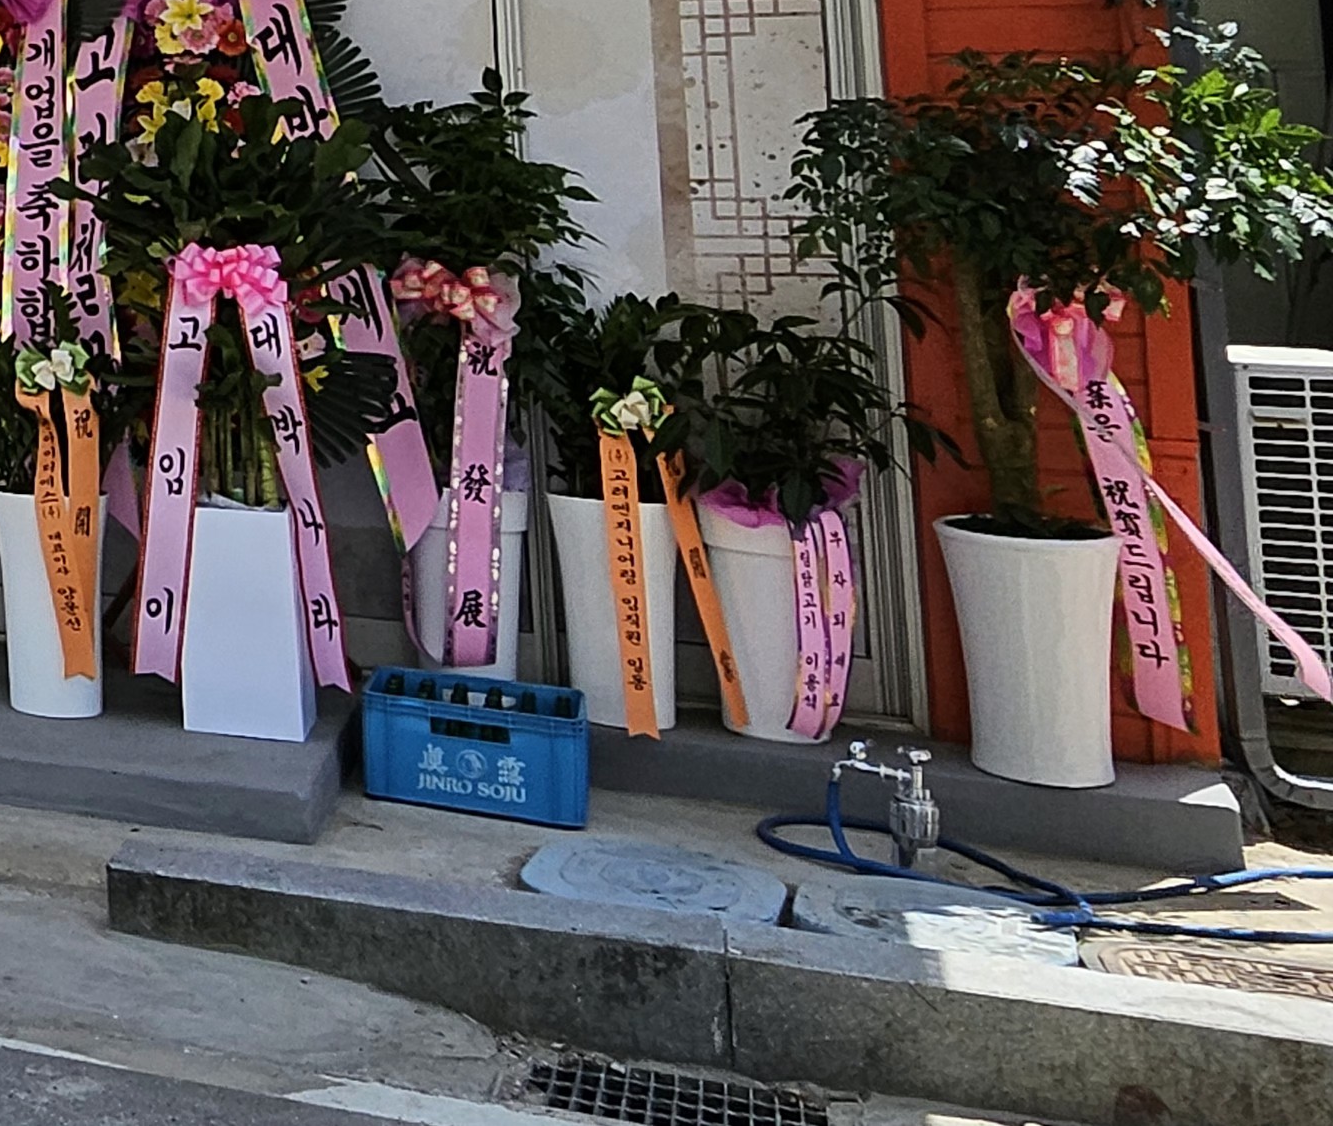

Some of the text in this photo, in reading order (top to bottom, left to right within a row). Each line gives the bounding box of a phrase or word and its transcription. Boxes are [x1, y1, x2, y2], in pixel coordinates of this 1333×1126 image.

[20, 29, 60, 169] 개업을
[146, 316, 204, 635] 고임이
[251, 312, 339, 643] 대박나라
[829, 530, 848, 708] 부자되세요
[417, 772, 527, 804] JINRO SOJU
